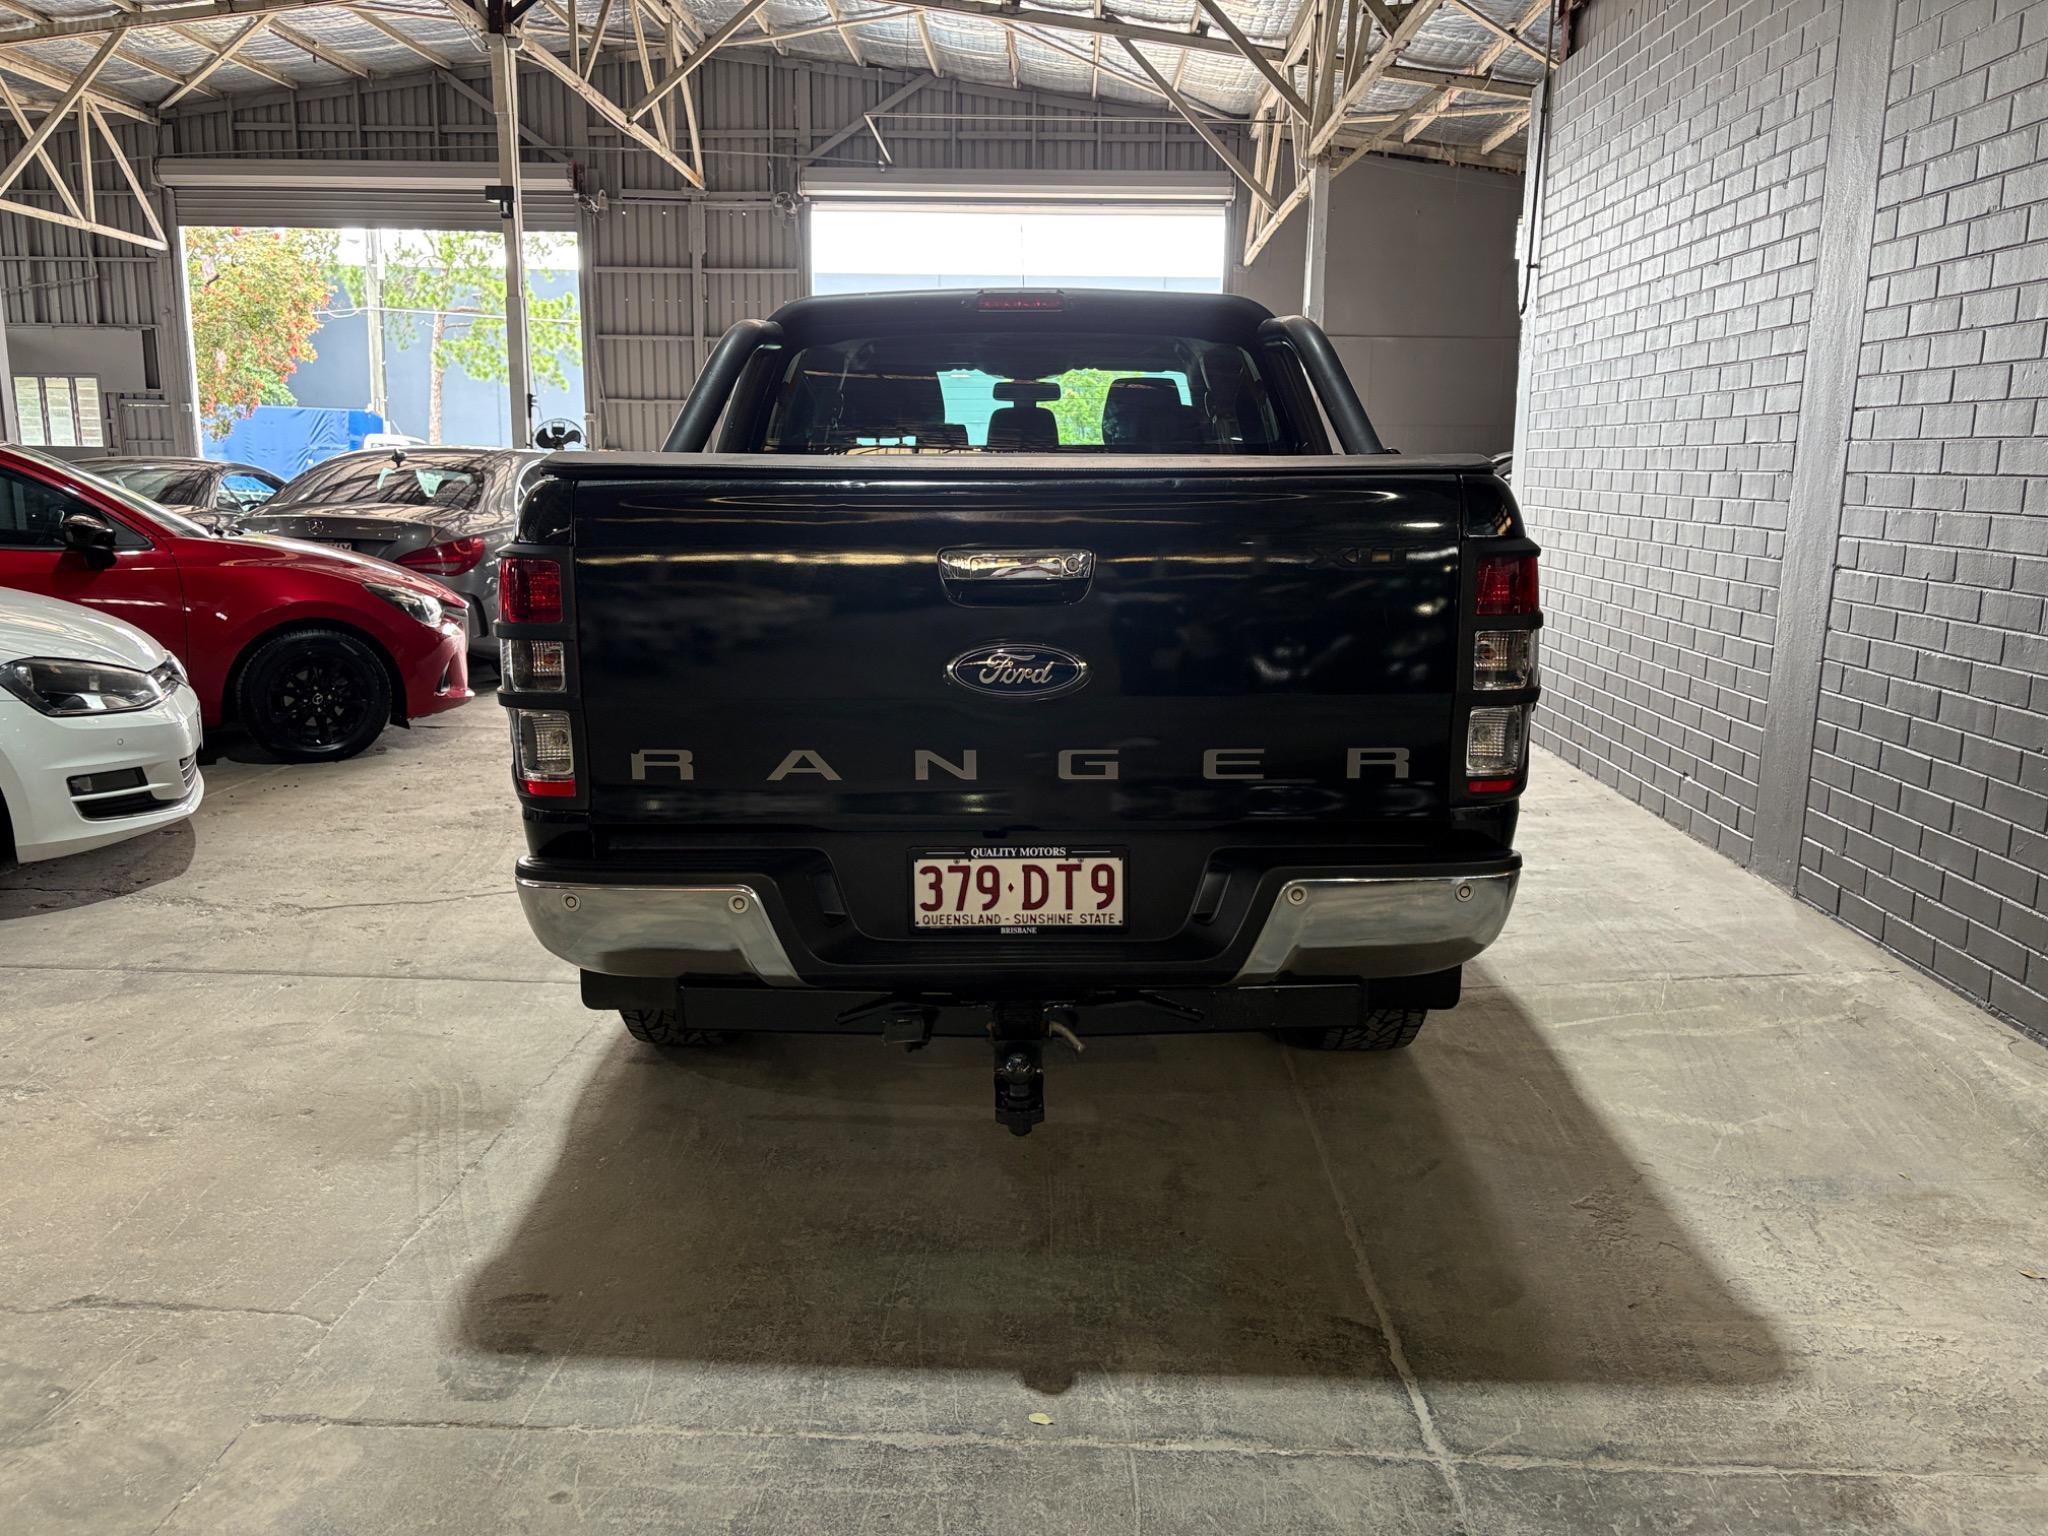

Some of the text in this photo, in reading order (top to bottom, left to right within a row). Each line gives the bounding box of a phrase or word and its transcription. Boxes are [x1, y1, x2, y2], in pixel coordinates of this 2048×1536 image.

[1305, 545, 1422, 569] XLT
[979, 652, 1053, 684] Ford
[631, 747, 1411, 781] RANGER
[970, 847, 1066, 858] QUALITY MOTORS
[922, 914, 1001, 925] QUEENSLAND
[1014, 913, 1073, 924] SUNSHINE
[1080, 913, 1116, 924] STATE
[1000, 927, 1037, 935] BRISBANE
